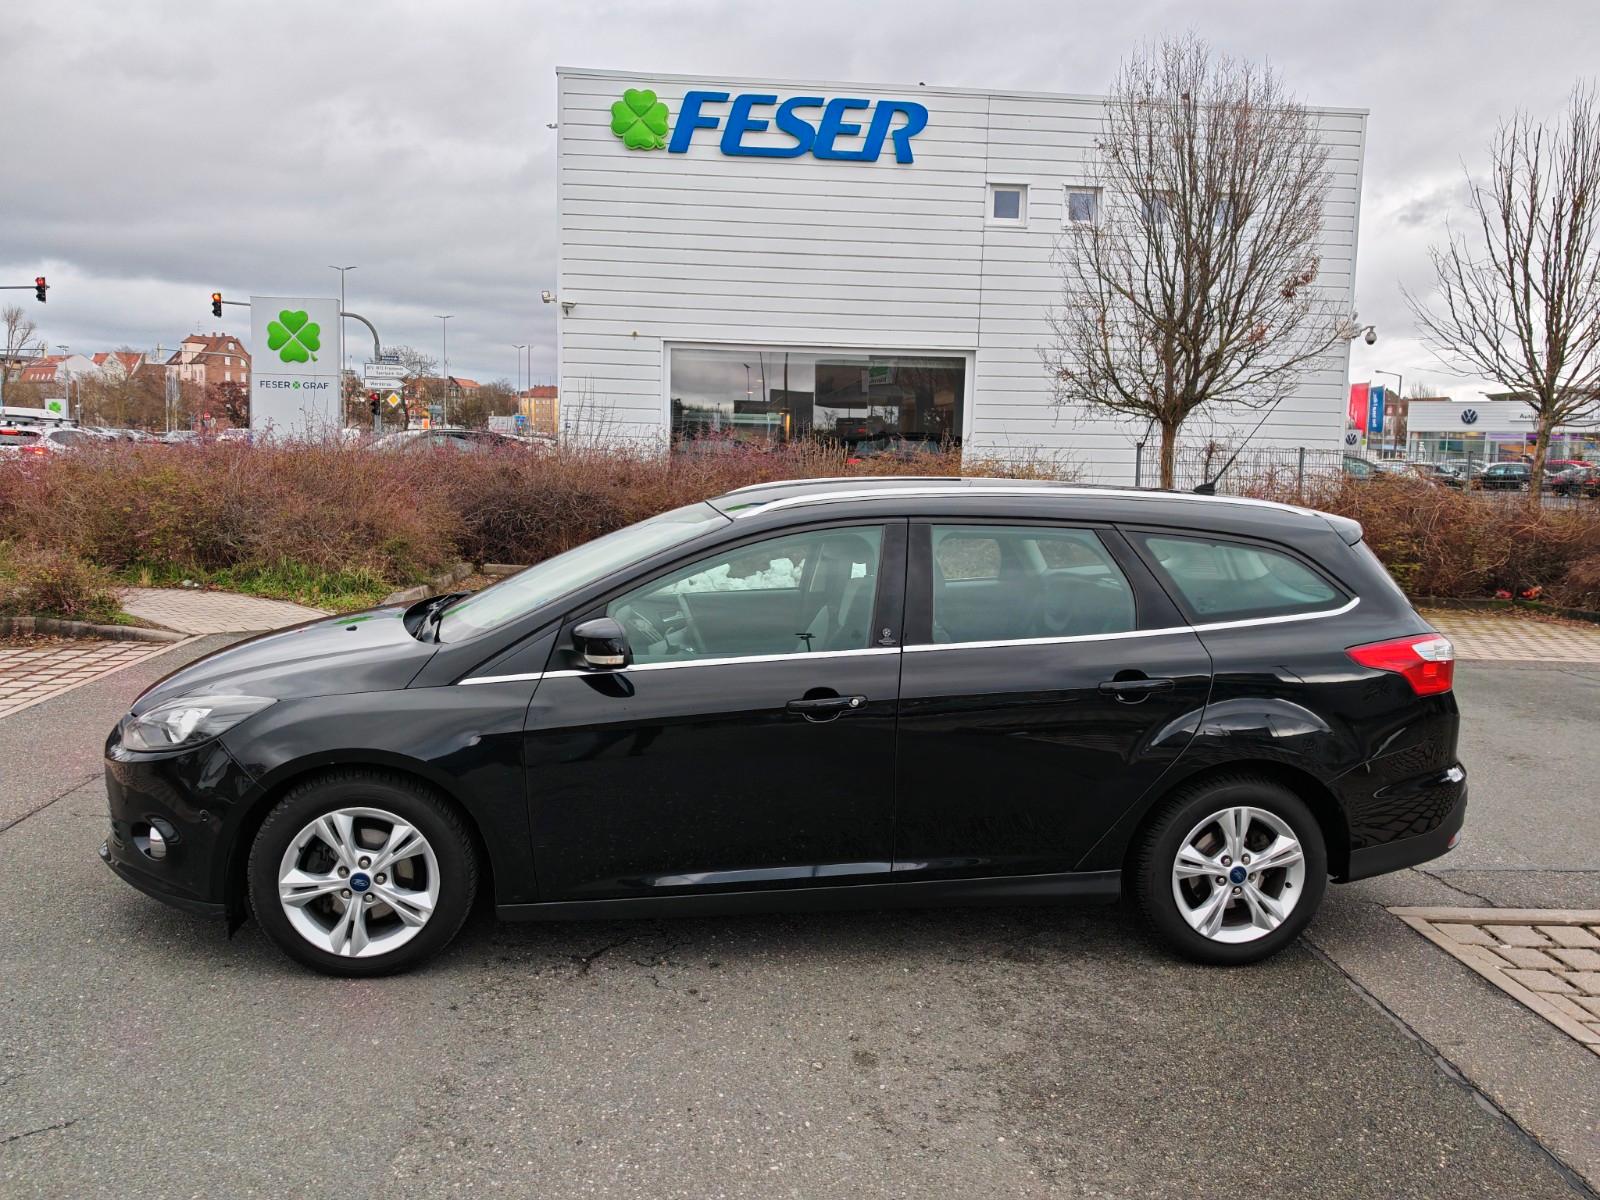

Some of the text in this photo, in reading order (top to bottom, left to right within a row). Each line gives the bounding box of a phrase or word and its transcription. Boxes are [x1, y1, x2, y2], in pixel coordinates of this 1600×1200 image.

[668, 91, 928, 164] FESER
[260, 380, 330, 390] FESER GRAF
